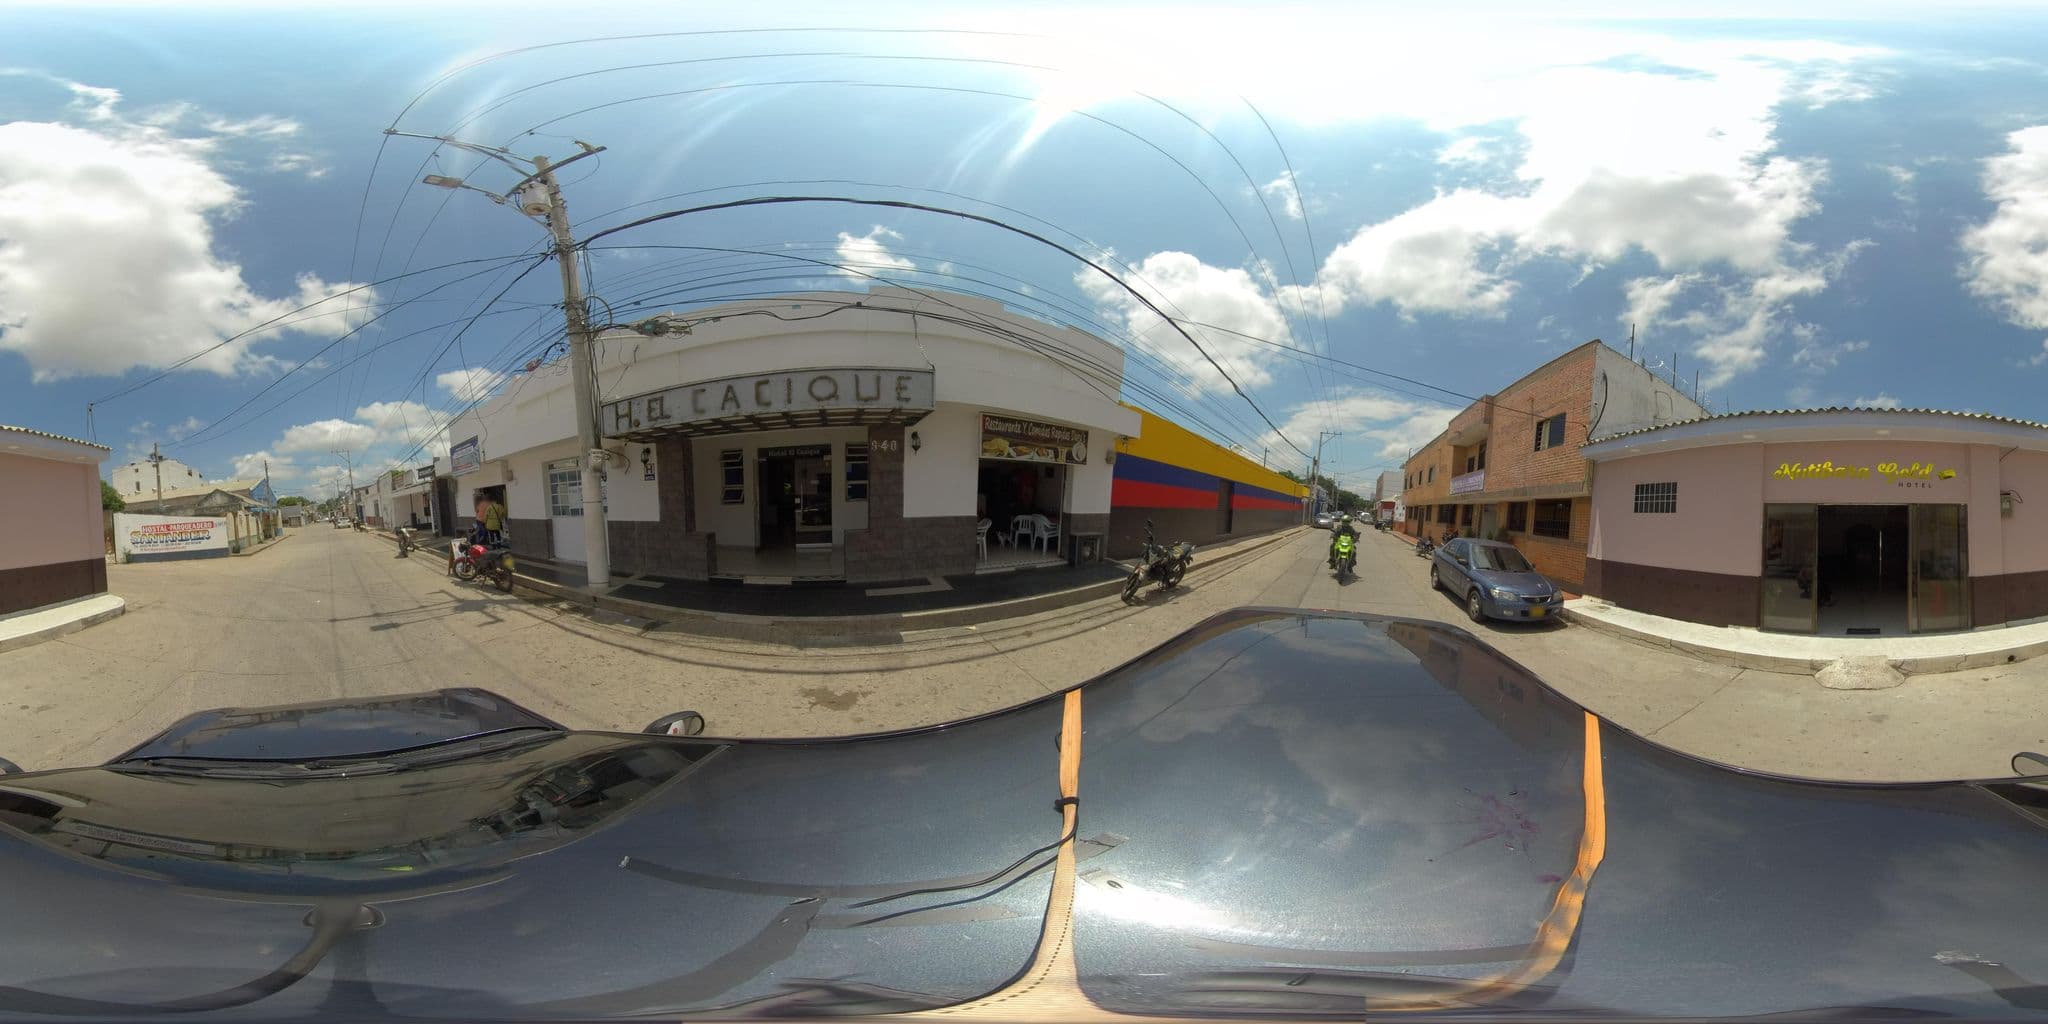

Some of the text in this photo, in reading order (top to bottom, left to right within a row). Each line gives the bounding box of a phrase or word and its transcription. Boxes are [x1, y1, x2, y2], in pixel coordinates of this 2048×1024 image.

[647, 396, 671, 421] EL
[691, 374, 913, 413] CACIQUE
[1877, 462, 1934, 484] Gold
